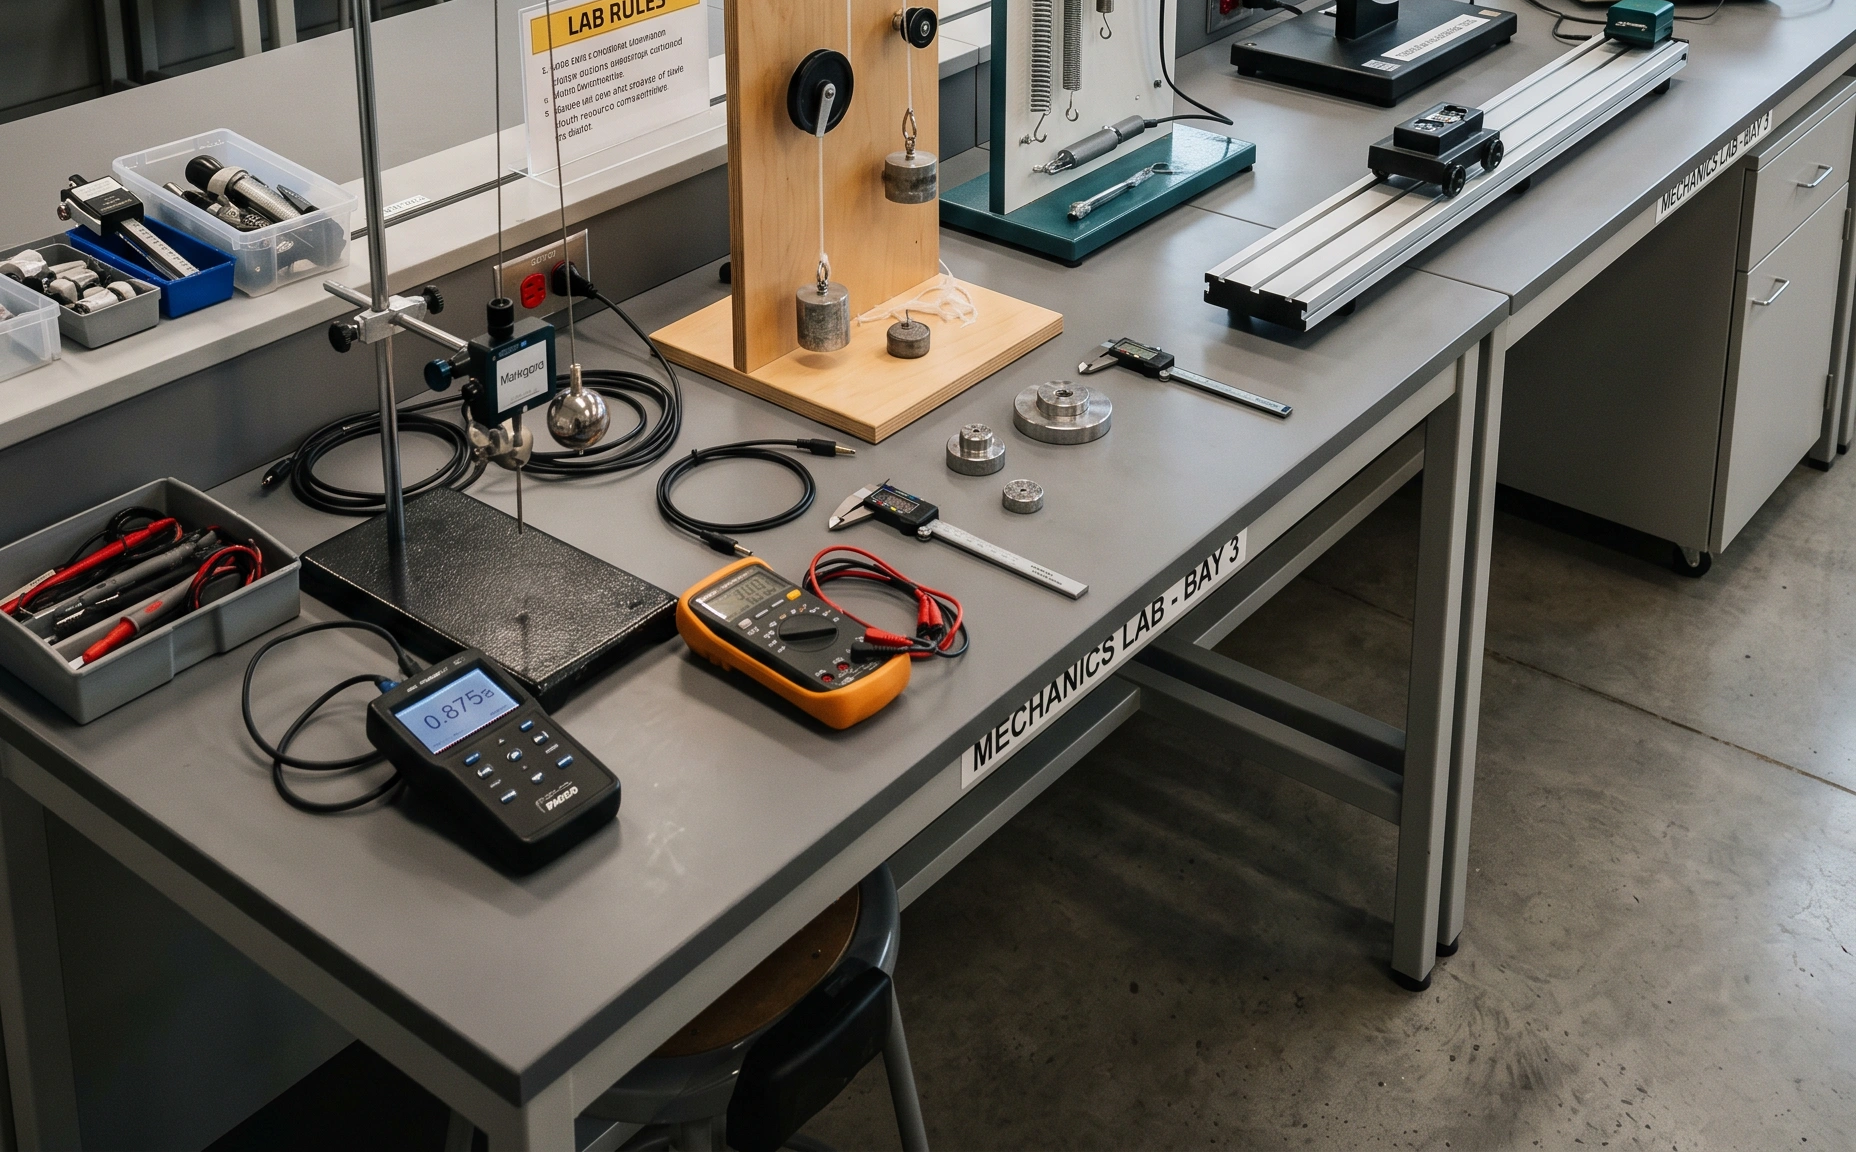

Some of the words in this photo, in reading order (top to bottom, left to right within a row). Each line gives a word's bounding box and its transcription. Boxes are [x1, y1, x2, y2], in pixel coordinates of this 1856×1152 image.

[568, 7, 605, 36] LAB
[973, 635, 1115, 772] MECHANICS
[1122, 596, 1165, 652] LAB
[1184, 546, 1225, 601] BAY
[1229, 535, 1239, 563] 3
